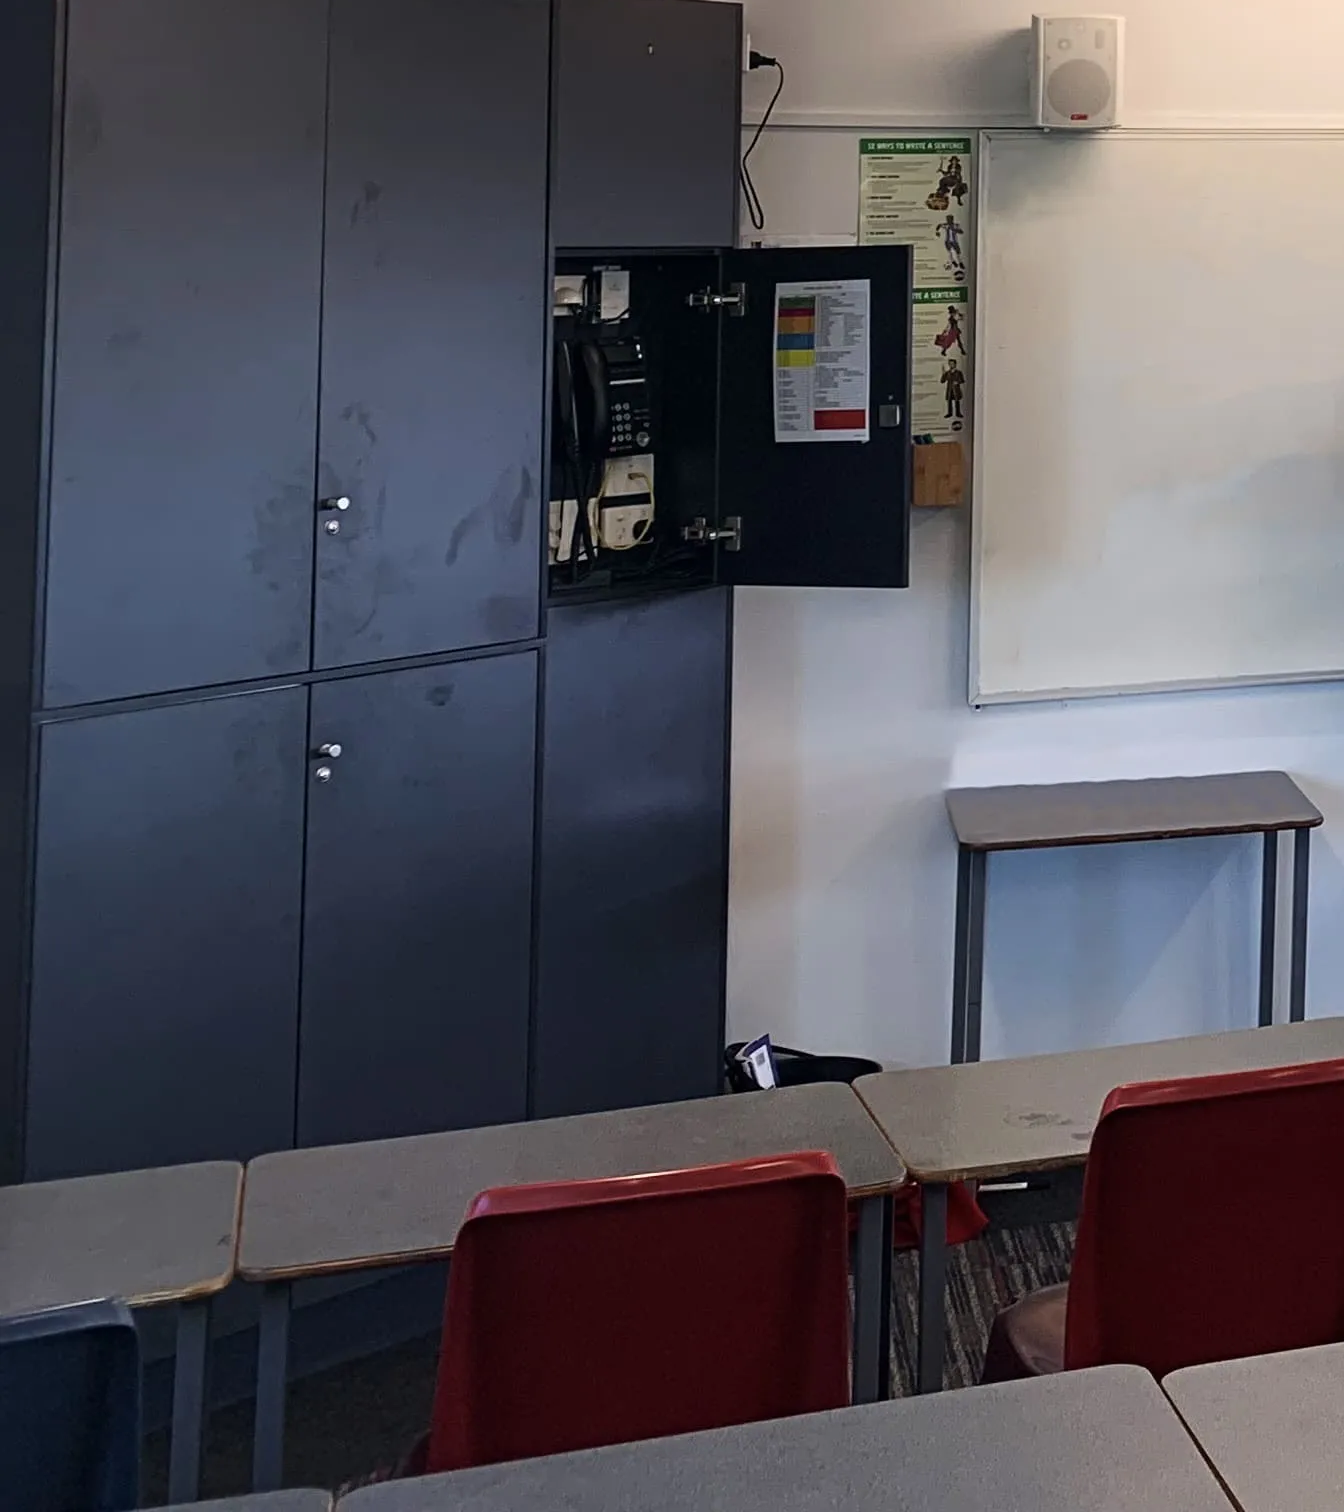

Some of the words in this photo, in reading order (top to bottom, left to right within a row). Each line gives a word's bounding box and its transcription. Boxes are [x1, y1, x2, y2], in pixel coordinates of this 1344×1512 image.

[877, 142, 894, 150] WAYS
[906, 142, 926, 150] WRITE
[931, 291, 961, 299] SENTENCE
